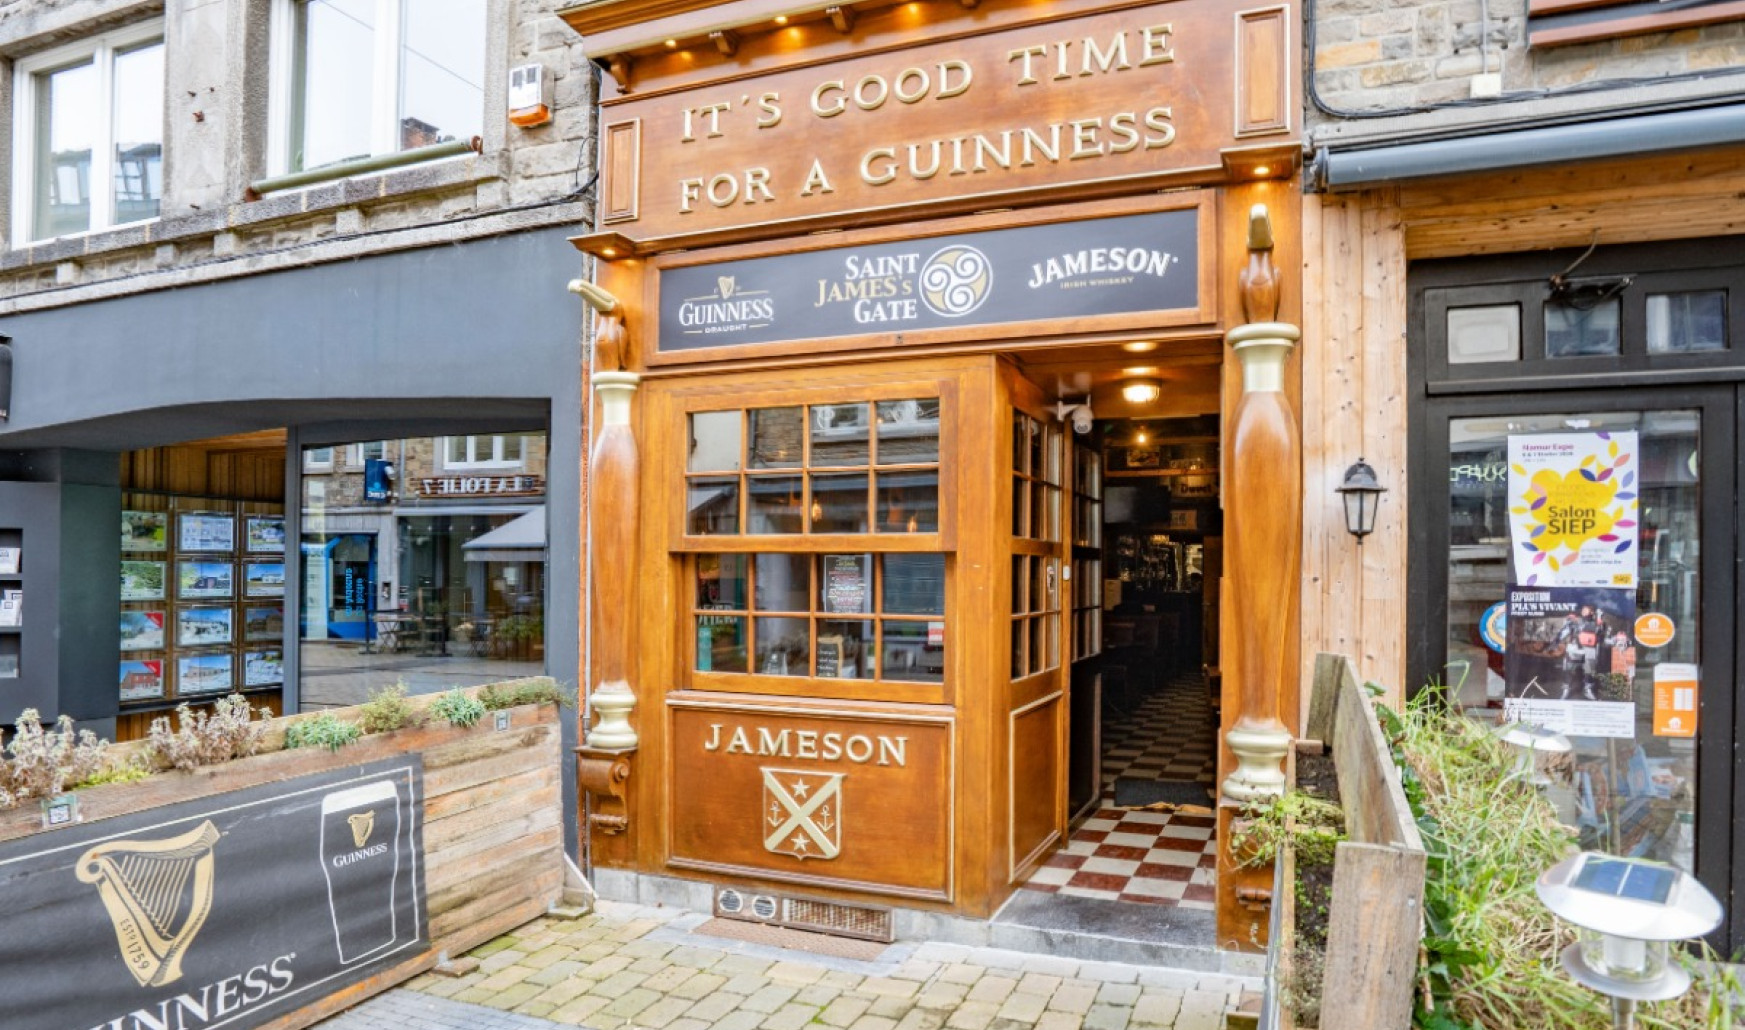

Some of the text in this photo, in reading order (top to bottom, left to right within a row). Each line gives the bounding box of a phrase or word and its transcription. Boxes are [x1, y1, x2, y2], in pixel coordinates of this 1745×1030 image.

[809, 58, 973, 118] GOOD
[1007, 22, 1174, 85] TIME
[679, 106, 1176, 213] FOR A GUINNESS
[845, 253, 919, 280] SAINT
[1028, 247, 1171, 288] JAMESON
[1060, 276, 1134, 289] IRISH WHISKEY
[679, 298, 773, 326] GUINNESS
[854, 299, 918, 323] GATE
[705, 323, 748, 333] DRAUGHT
[1548, 505, 1596, 518] Salon
[1548, 519, 1596, 535] SIEP
[704, 723, 909, 767] JAMESON
[333, 843, 387, 867] GUINNESS
[128, 942, 150, 969] 1759
[90, 954, 294, 1030] NNESS
